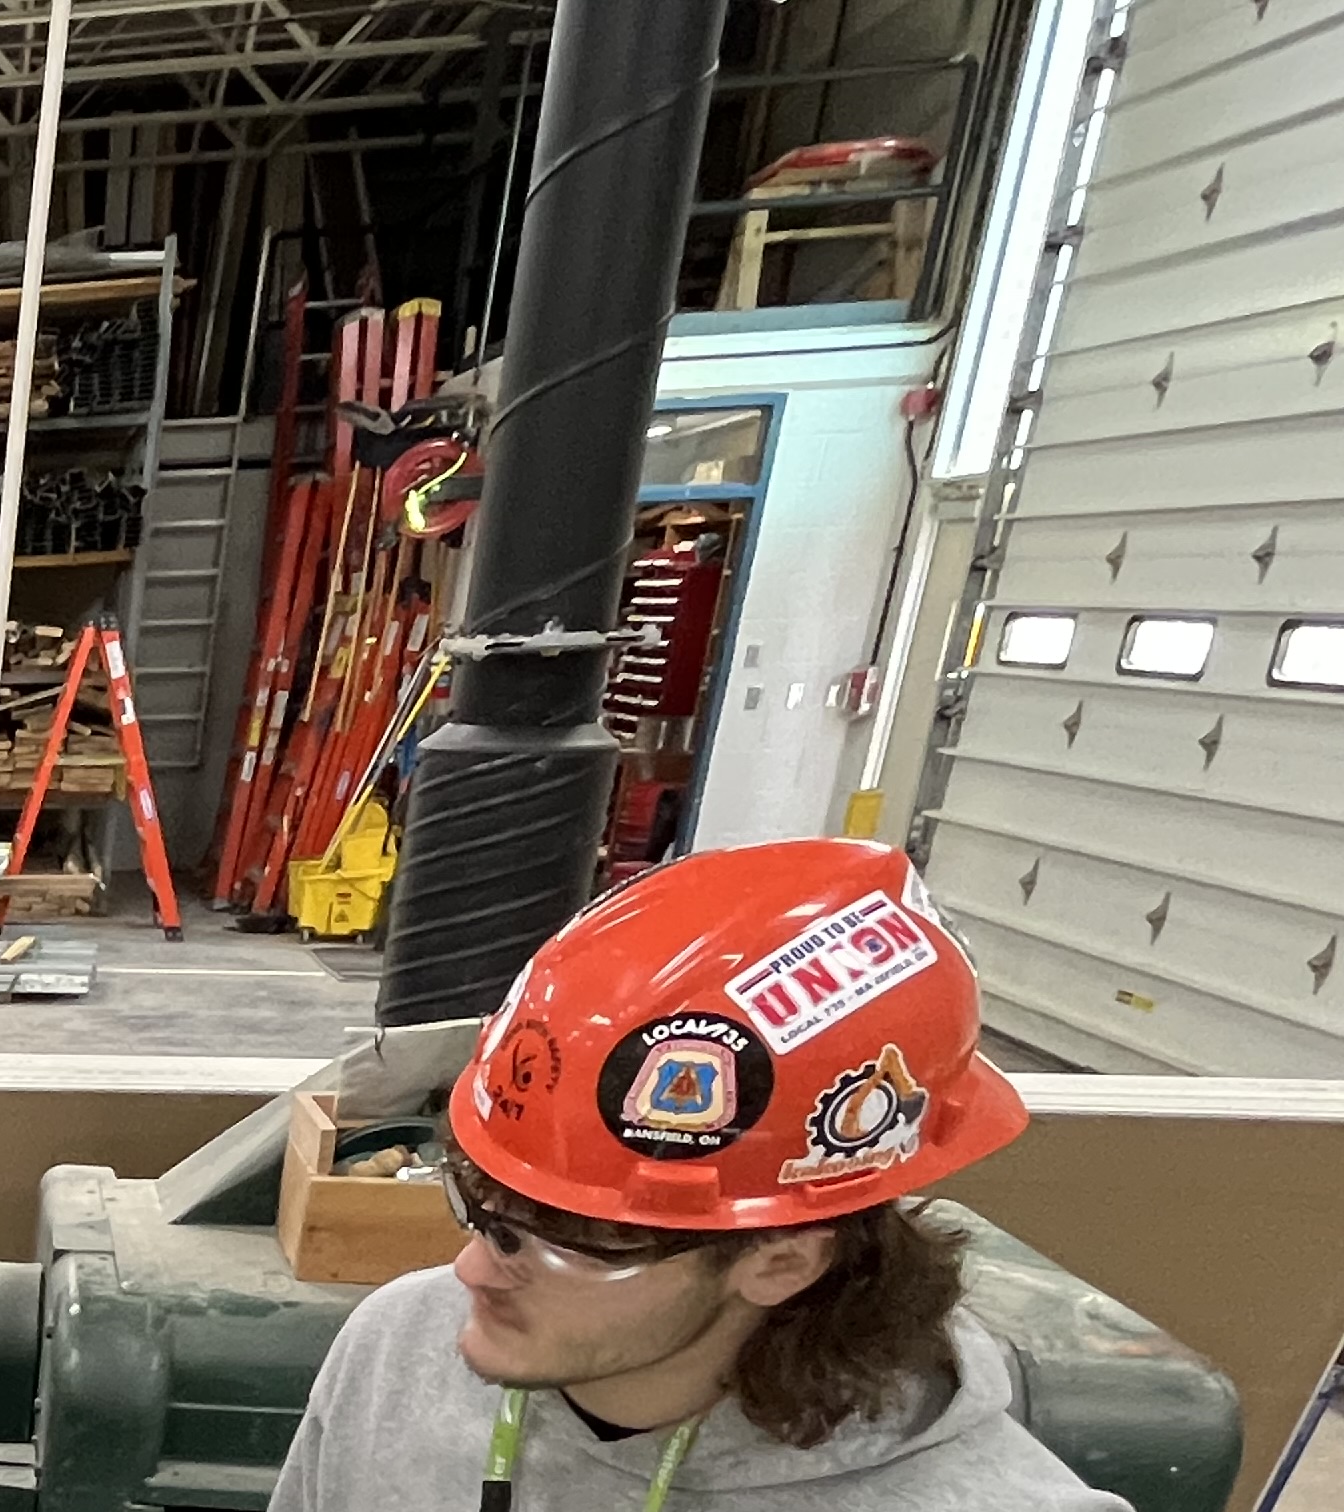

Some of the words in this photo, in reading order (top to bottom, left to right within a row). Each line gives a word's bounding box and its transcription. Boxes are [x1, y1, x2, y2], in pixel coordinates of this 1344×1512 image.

[769, 930, 826, 974] PROUD
[821, 919, 846, 940] TO
[841, 910, 867, 930] BE
